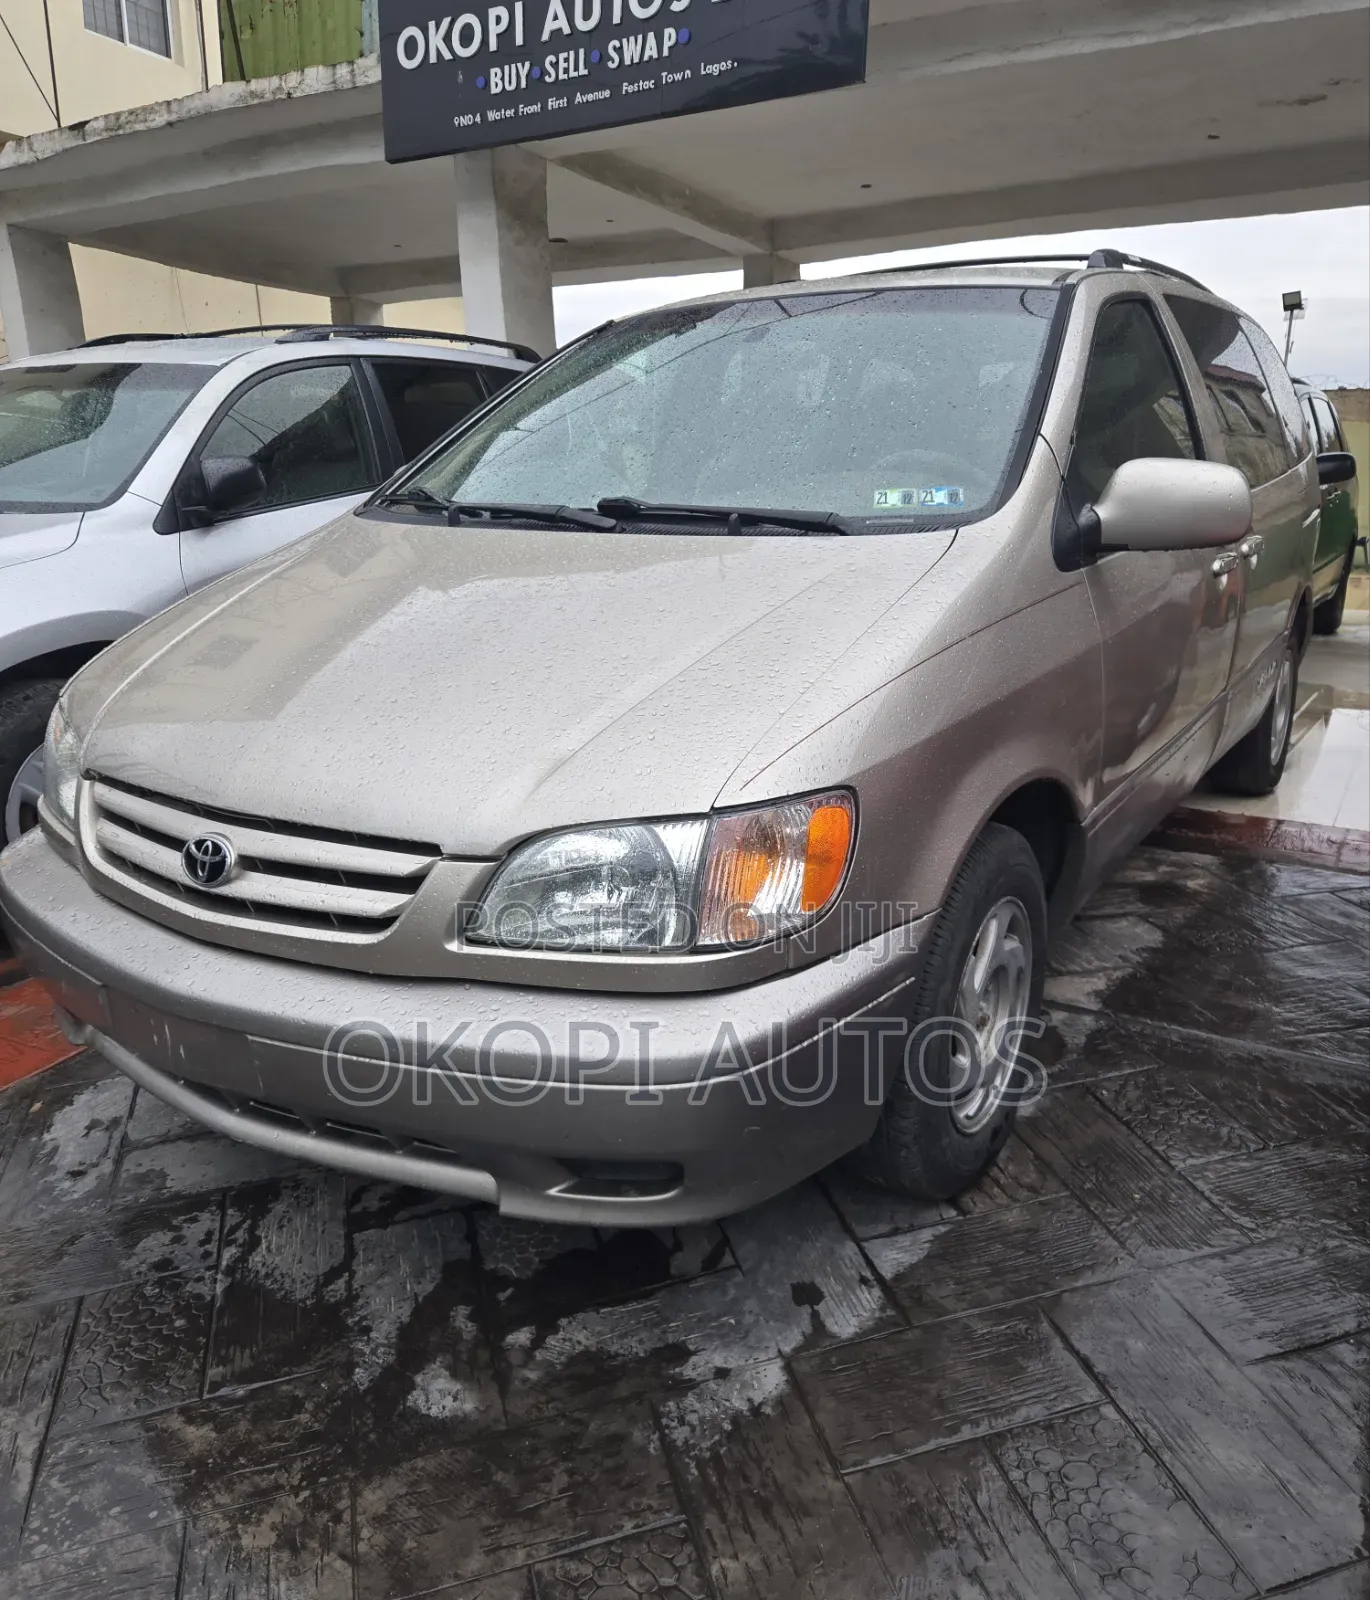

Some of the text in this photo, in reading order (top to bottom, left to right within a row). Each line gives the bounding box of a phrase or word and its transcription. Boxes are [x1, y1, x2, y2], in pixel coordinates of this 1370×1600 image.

[396, 1, 524, 70] OKOPI
[489, 27, 677, 95] BUY SELL SWAP
[487, 108, 515, 122] Water
[518, 102, 541, 116] Front
[548, 96, 567, 110] First
[574, 89, 611, 105] Avenue
[622, 79, 655, 95] Festac
[661, 69, 692, 85] Town
[876, 491, 889, 505] 21
[922, 489, 935, 503] 21
